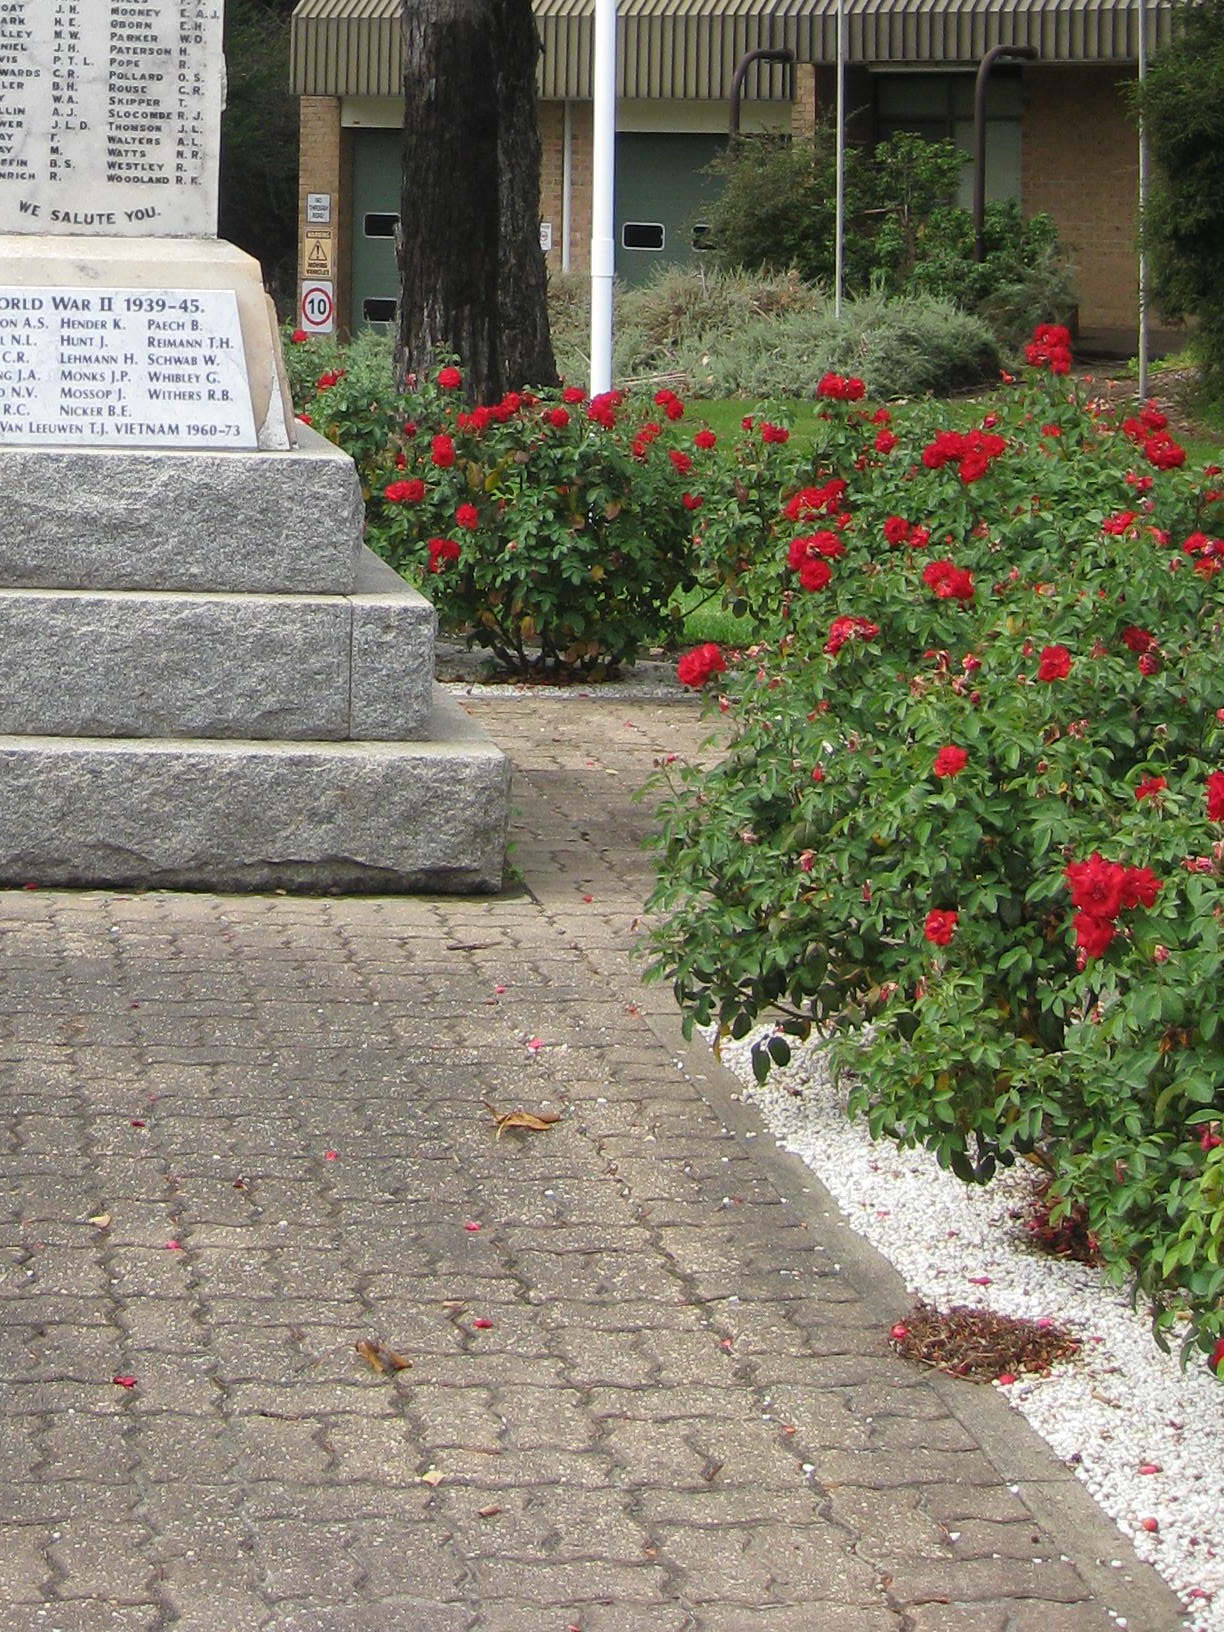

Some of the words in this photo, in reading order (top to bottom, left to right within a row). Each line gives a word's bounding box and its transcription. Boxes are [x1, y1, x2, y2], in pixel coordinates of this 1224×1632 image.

[110, 7, 161, 17] MOONEY
[110, 32, 159, 43] PARKER
[109, 44, 172, 56] PATERSON
[109, 57, 141, 68] POPE
[109, 70, 164, 82] POLLARD
[108, 83, 147, 94] ROUSE
[108, 96, 161, 107] SKIPPER
[107, 134, 161, 146] WALTERS
[107, 148, 146, 158] WATTS
[106, 160, 165, 172] WESTLEY
[19, 200, 41, 217] WE
[50, 209, 116, 225] SALUTE
[124, 206, 161, 222] YOU.
[51, 296, 92, 312] WAR
[99, 297, 113, 312] II
[307, 298, 327, 315] 10
[60, 318, 107, 331] HENDER
[113, 318, 126, 331] K.
[147, 319, 186, 332] PAECH
[191, 319, 203, 332] B.
[60, 335, 94, 347] HUNT
[99, 335, 108, 349] J.
[147, 336, 203, 349] REIMANN
[60, 353, 118, 365] LEHMANN
[123, 353, 139, 366] H.
[147, 353, 198, 366] SCHWAB
[203, 354, 220, 367] W.
[60, 370, 106, 383] MONKS
[148, 371, 201, 384] WHIBLEY
[206, 371, 221, 385] G.
[59, 387, 113, 400] MOSSOP
[117, 388, 126, 402] J.
[148, 388, 202, 402] WITHERS
[59, 404, 103, 418] NICKER
[0, 421, 24, 434] VAN
[29, 421, 84, 435] LEEUWEN
[114, 423, 180, 437] VIETNAM
[185, 424, 241, 438] 1960-73
